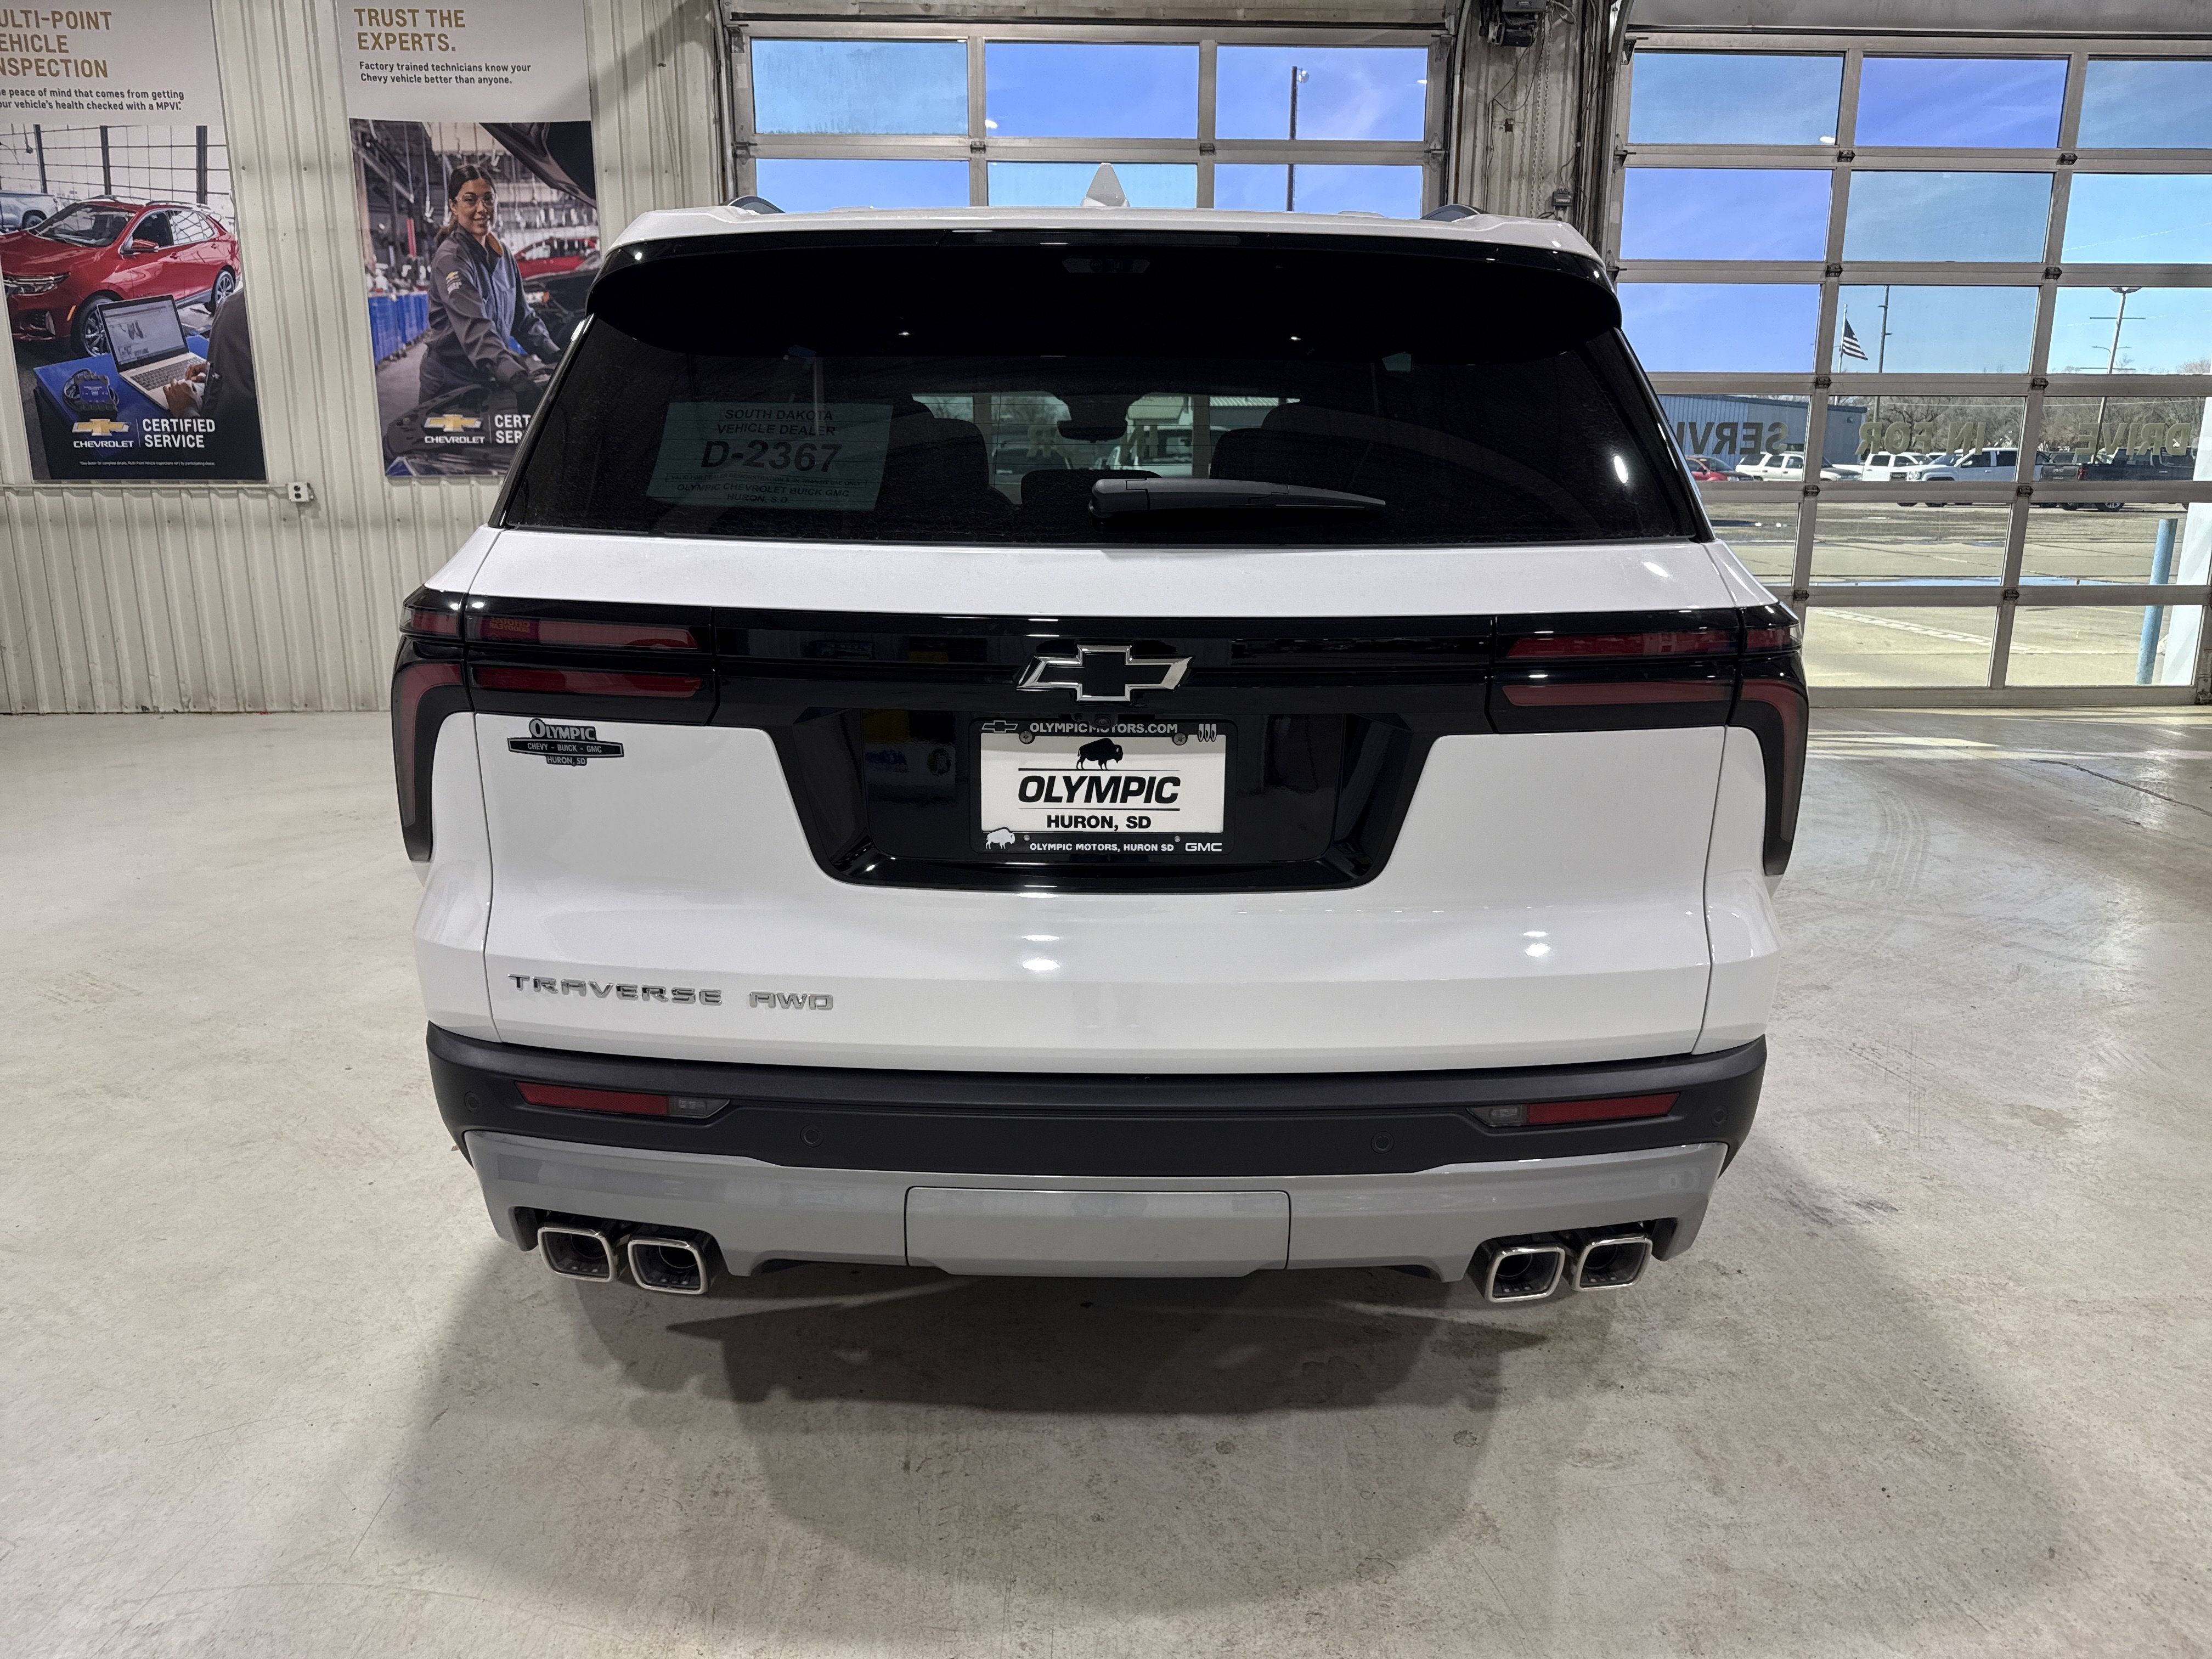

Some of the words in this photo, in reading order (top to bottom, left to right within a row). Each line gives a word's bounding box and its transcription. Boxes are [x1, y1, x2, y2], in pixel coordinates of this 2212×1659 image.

[354, 8, 419, 27] TRUST
[425, 9, 466, 28] THE
[357, 32, 456, 52] EXPERTS.
[359, 61, 394, 72] Factory
[396, 62, 429, 72] trained
[431, 63, 483, 72] technicians
[485, 63, 509, 72] know
[511, 64, 531, 74] your
[360, 72, 388, 84] Chevy
[391, 74, 422, 83] vehicle
[424, 74, 452, 84] better
[454, 75, 475, 84] than
[477, 76, 512, 86] anyone.
[9, 89, 36, 98] peace
[38, 88, 47, 97] of
[49, 88, 72, 97] mind
[74, 89, 94, 98] that
[127, 89, 149, 98] from
[151, 89, 184, 100] getting
[14, 100, 53, 109] vehicle's
[55, 100, 84, 110] health
[86, 101, 123, 110] checked
[126, 101, 146, 110] with
[724, 409, 772, 421] SOUTH
[776, 409, 833, 421] DAKOTA
[143, 419, 216, 432] CERTIFIED
[716, 422, 776, 435] VEHICLE
[779, 424, 836, 436] DEALER
[73, 440, 134, 448] CHEVROLET
[144, 434, 205, 448] SERVICE
[425, 436, 485, 444] CHEVROLET
[700, 439, 843, 473] D-2367
[677, 483, 720, 492] OLYMPIC
[723, 482, 787, 494] CHEVROLET
[789, 487, 823, 496] BUICK
[825, 488, 850, 498] GMC
[727, 493, 768, 503] HURON,
[529, 719, 596, 741] OLYMPIC
[527, 742, 548, 751] CHEVY
[586, 745, 602, 753] GMC
[547, 755, 575, 765] HURON,
[1018, 775, 1181, 804] OLYMPIC
[1046, 815, 1119, 832] HURON,
[1126, 815, 1152, 829] SD
[1029, 842, 1073, 851] OLYMPIC
[1075, 843, 1121, 853] MOTORS,
[1123, 843, 1159, 851] HURON
[1160, 844, 1175, 852] SD
[1184, 842, 1222, 852] GMC
[507, 973, 723, 1006] TRAVERSE
[748, 990, 834, 1011] AWD
